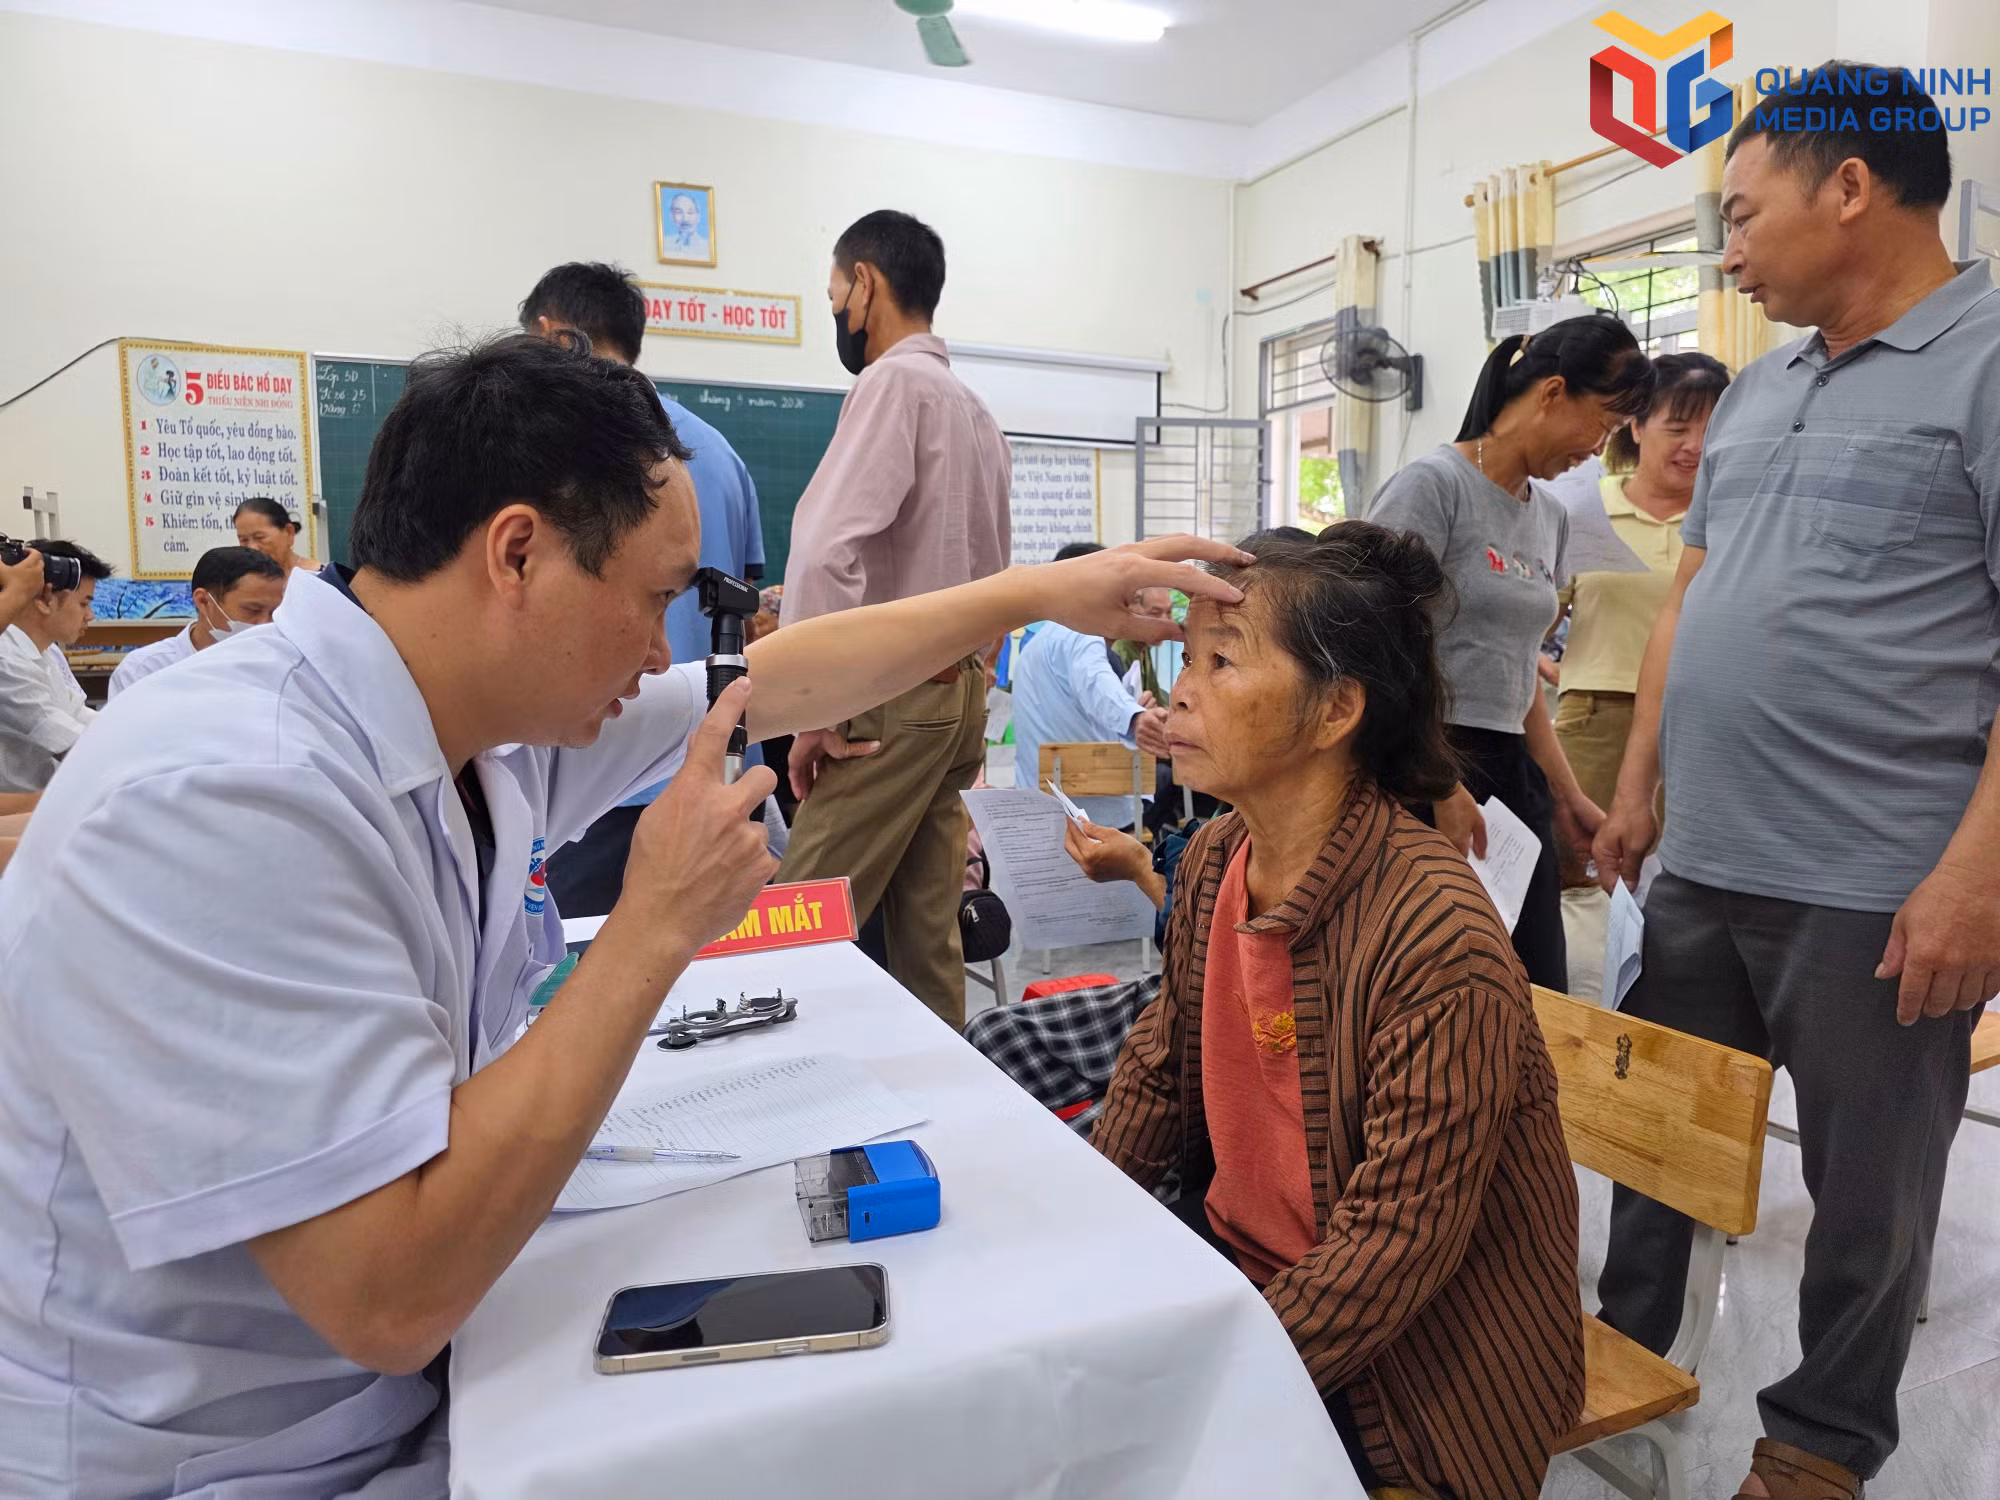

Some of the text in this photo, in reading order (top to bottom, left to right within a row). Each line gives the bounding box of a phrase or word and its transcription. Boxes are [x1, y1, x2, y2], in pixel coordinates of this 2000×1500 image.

[677, 295, 707, 323] TỐT
[723, 304, 755, 331] HỌC
[760, 302, 787, 329] TỐT
[185, 368, 204, 405] 5
[233, 371, 254, 391] BÁC
[273, 377, 292, 397] DẠY
[344, 370, 358, 382] 5D
[141, 420, 147, 430] 1
[156, 418, 176, 434] Yêu
[179, 416, 193, 435] Tổ
[196, 419, 224, 439] quốc,
[226, 422, 245, 440] yêu
[275, 423, 297, 439] bào.
[140, 442, 297, 465] 2 Học tập tốt, lao động tốt.
[159, 466, 190, 482] Đoàn
[193, 465, 212, 482] kết
[215, 466, 234, 486] tốt,
[254, 468, 277, 488] luật
[280, 468, 298, 485] tốt.
[160, 489, 183, 505] Giữ
[186, 490, 204, 509] gìn
[208, 491, 221, 510] vệ
[145, 516, 154, 527] 5
[162, 513, 198, 529] Khiêm
[201, 512, 223, 532] tốn,
[163, 535, 189, 552] cảm.
[768, 893, 823, 935] MẮT
